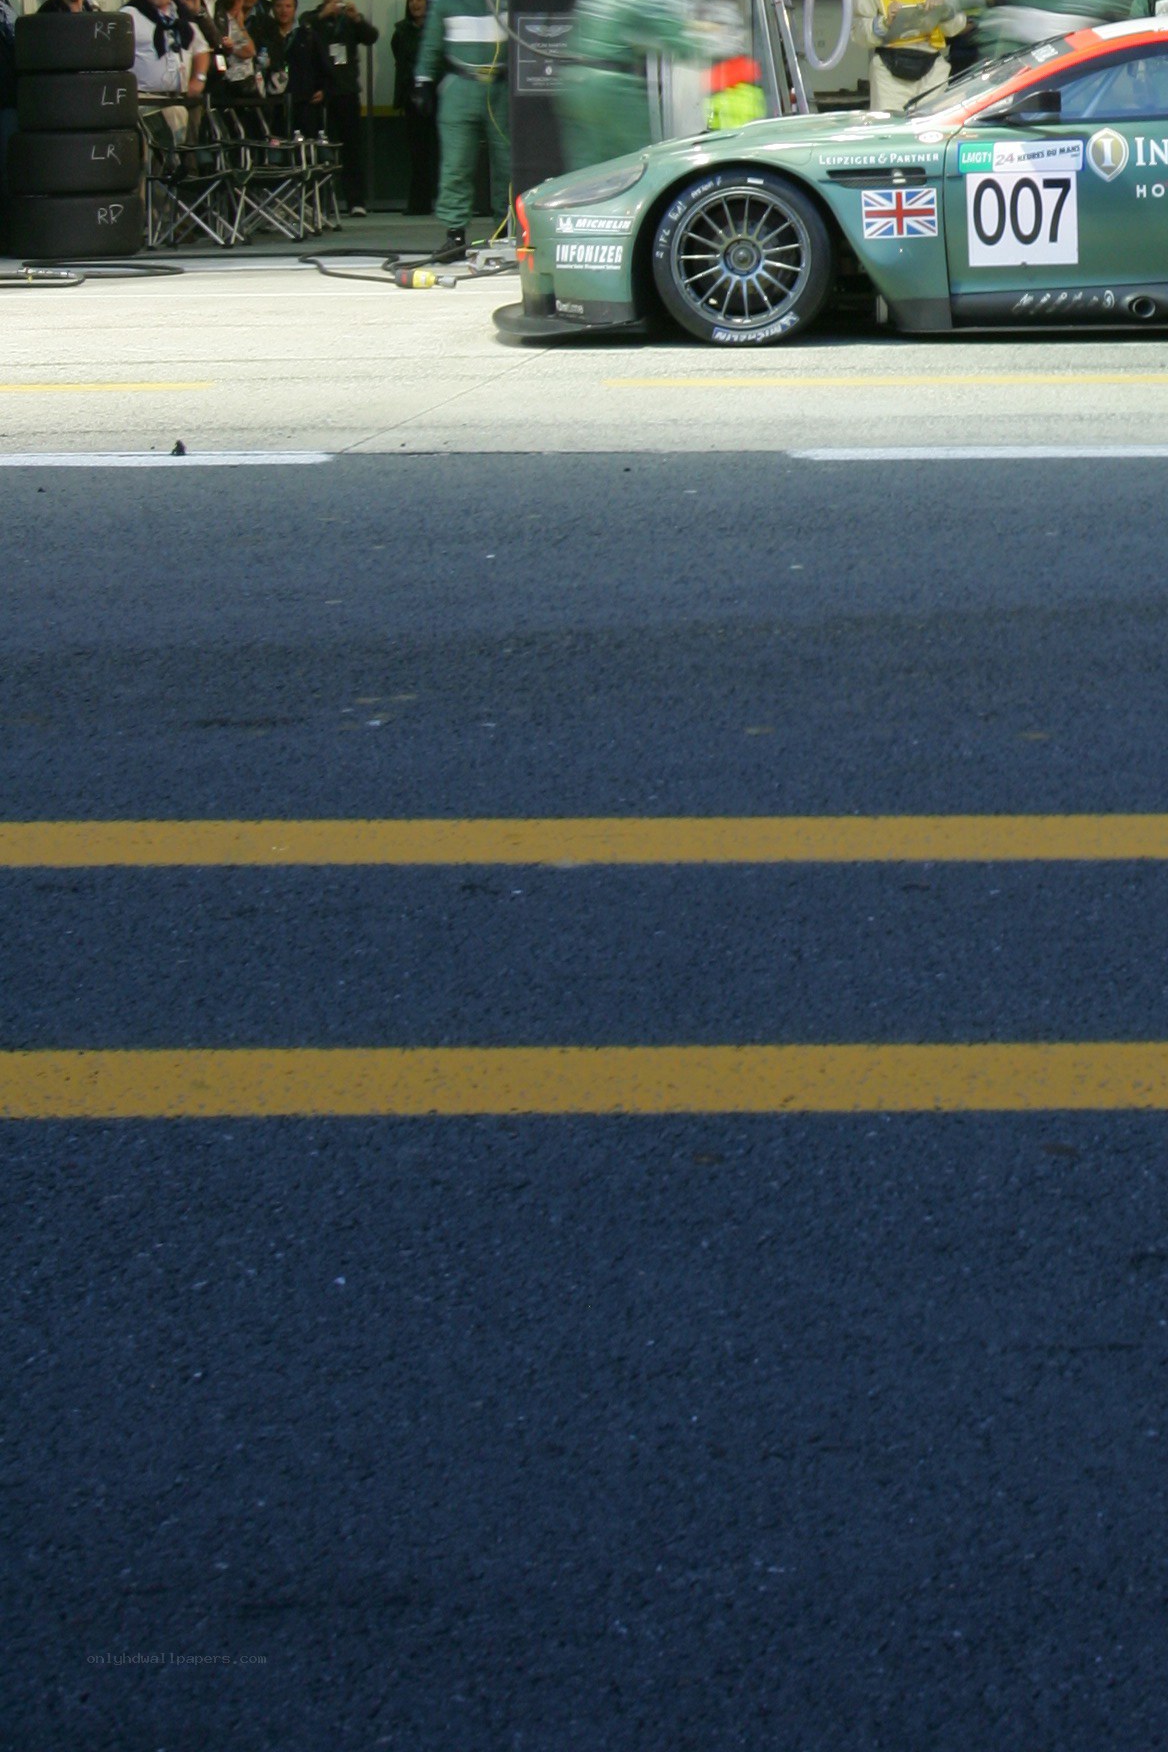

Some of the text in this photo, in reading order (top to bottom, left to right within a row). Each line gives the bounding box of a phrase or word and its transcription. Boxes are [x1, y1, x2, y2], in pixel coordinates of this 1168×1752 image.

[93, 22, 117, 41] RF
[102, 85, 127, 106] LF
[90, 144, 122, 166] LR
[819, 151, 940, 166] LEIPZIGER & PARTNER
[961, 152, 992, 164] LMGT1
[995, 153, 1015, 167] 24
[973, 177, 1072, 247] 007
[575, 218, 632, 230] MICHELIN
[555, 245, 624, 263] INFONIZER
